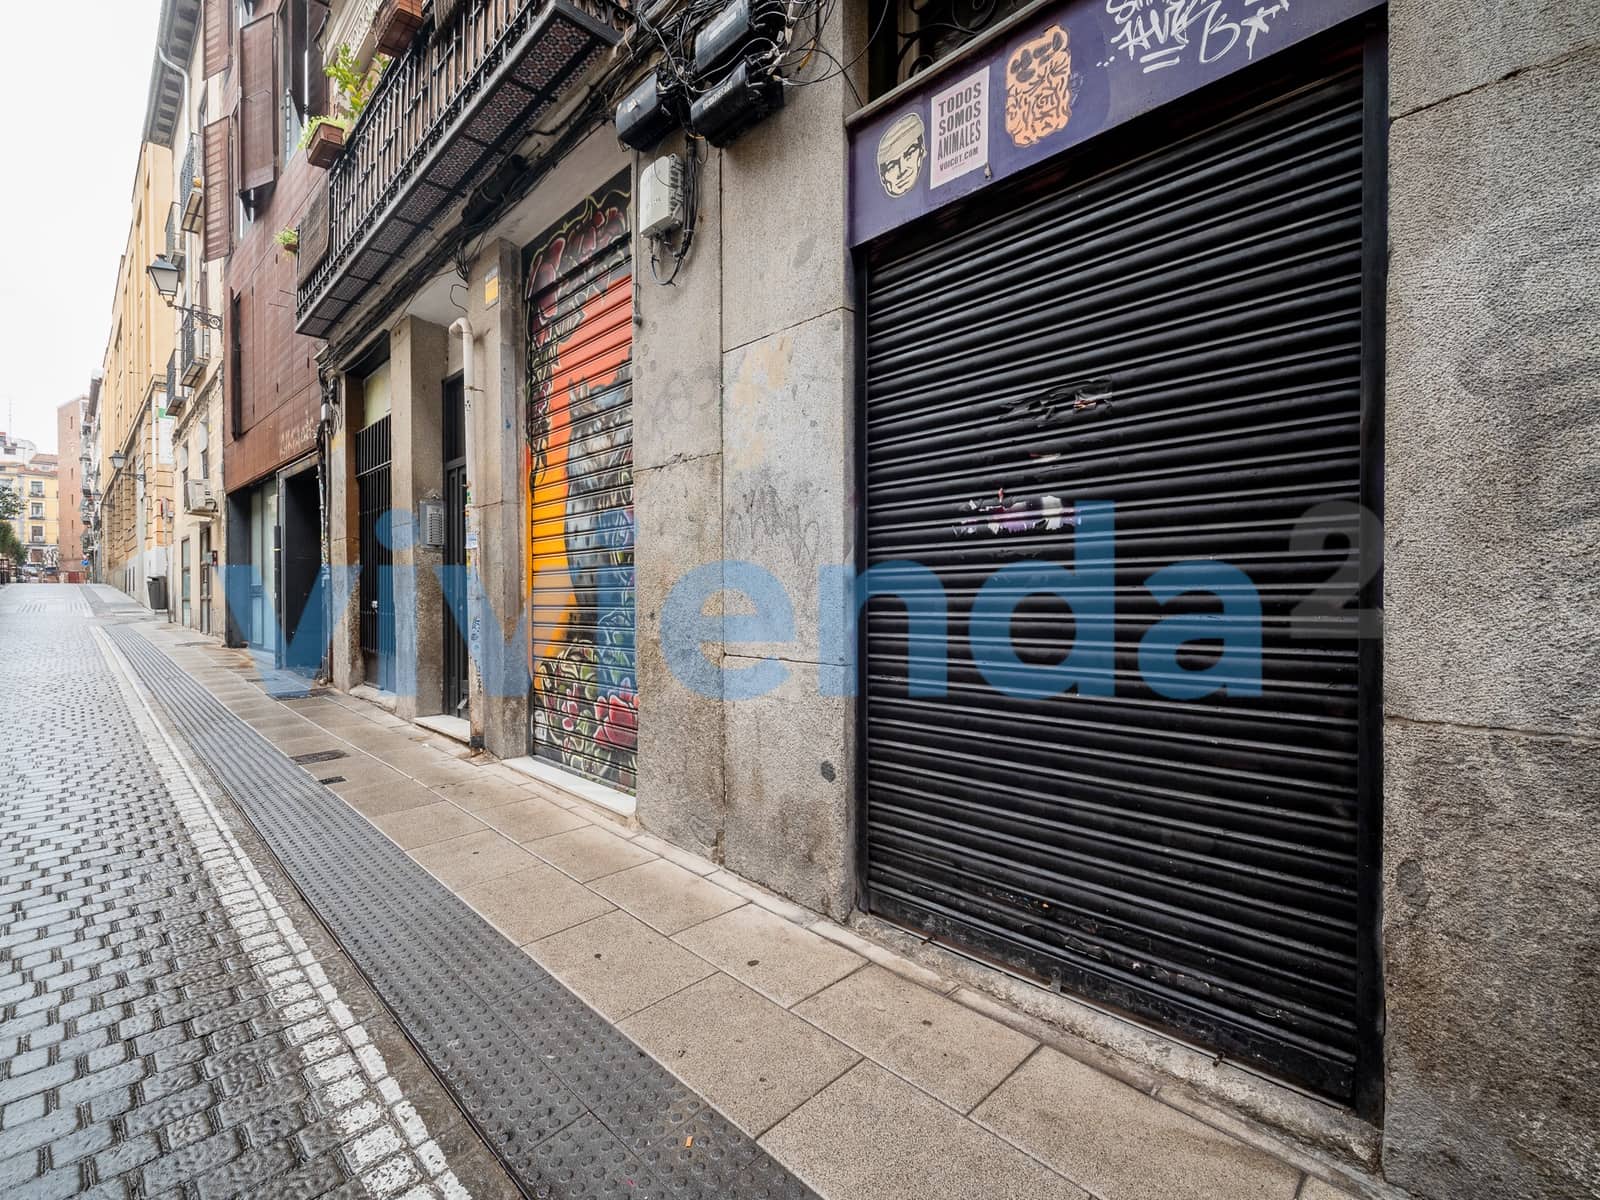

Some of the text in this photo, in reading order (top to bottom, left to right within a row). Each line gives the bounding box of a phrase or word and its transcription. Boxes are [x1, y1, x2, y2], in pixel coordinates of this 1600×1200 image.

[938, 82, 981, 118] TODOS
[938, 100, 981, 137] SOMOS
[937, 119, 981, 161] ANIMALES
